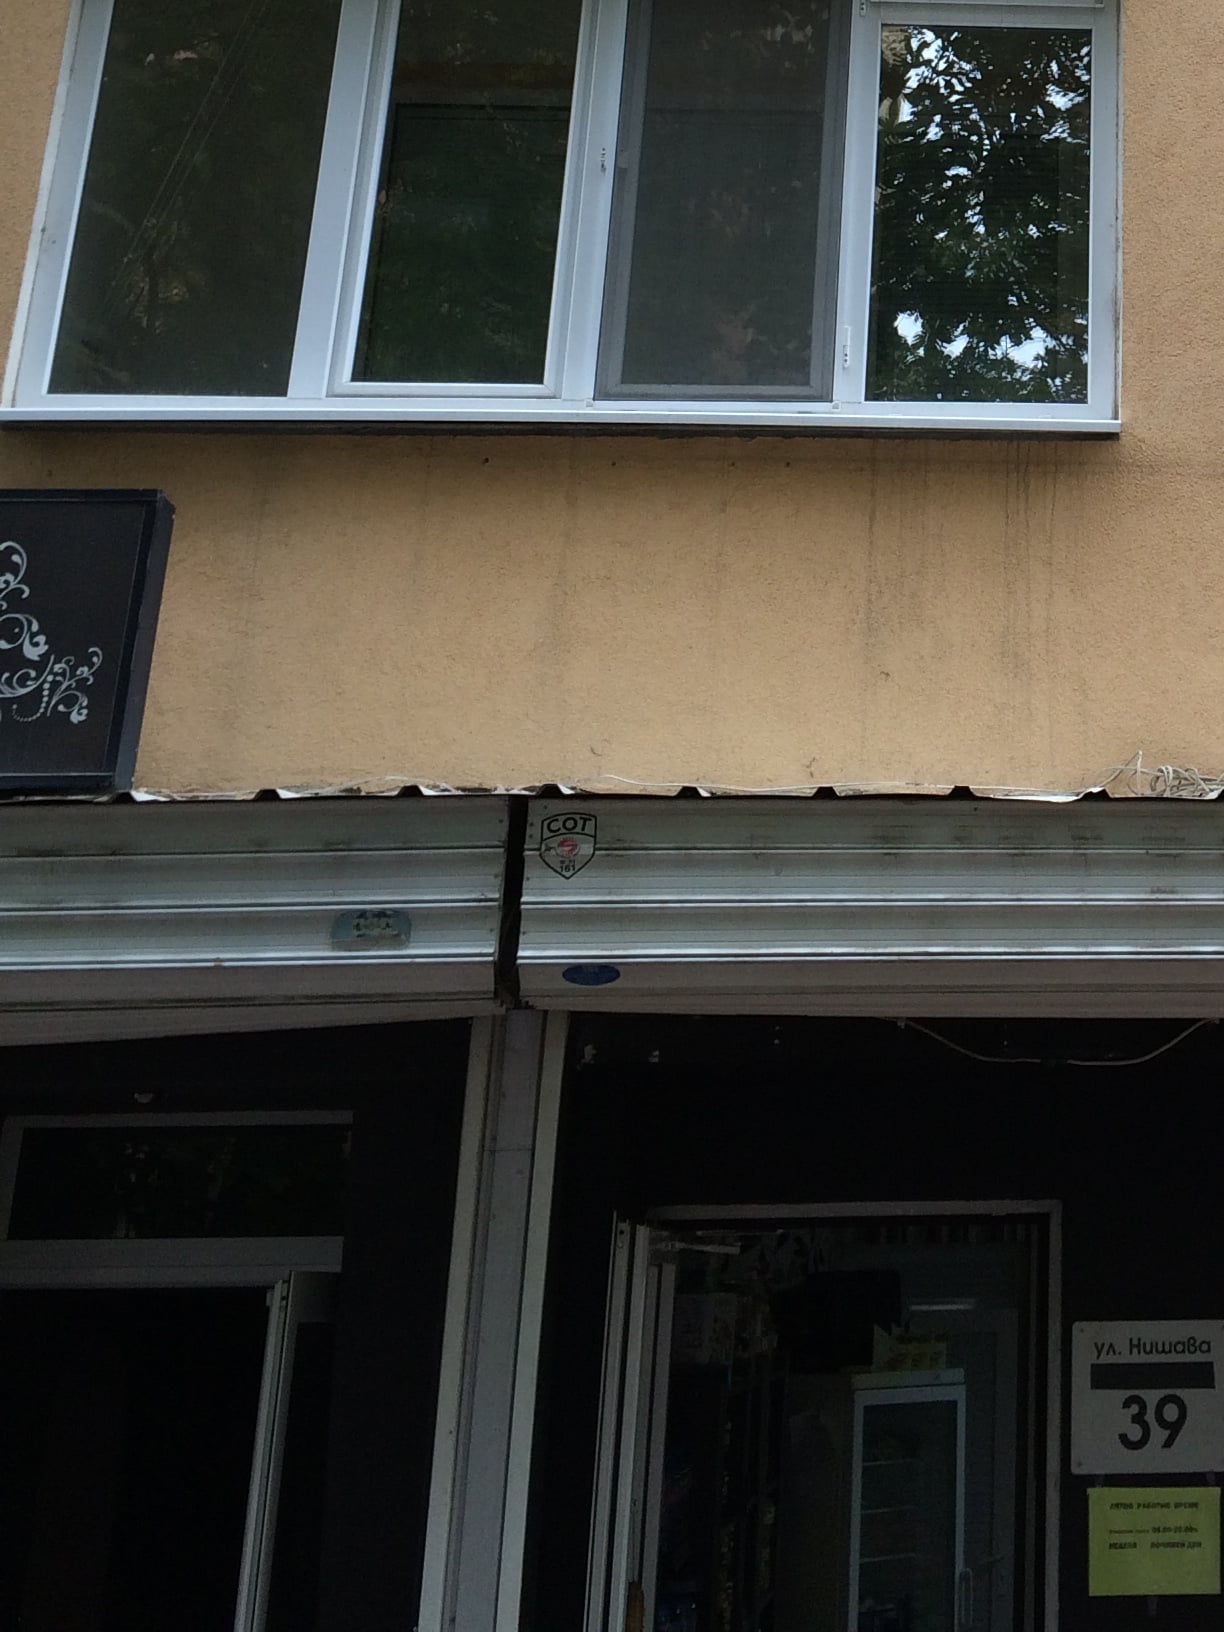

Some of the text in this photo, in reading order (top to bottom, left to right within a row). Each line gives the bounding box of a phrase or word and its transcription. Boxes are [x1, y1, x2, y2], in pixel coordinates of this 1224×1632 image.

[1093, 1336, 1212, 1360] ул. Нишава
[1118, 1393, 1188, 1451] 39
